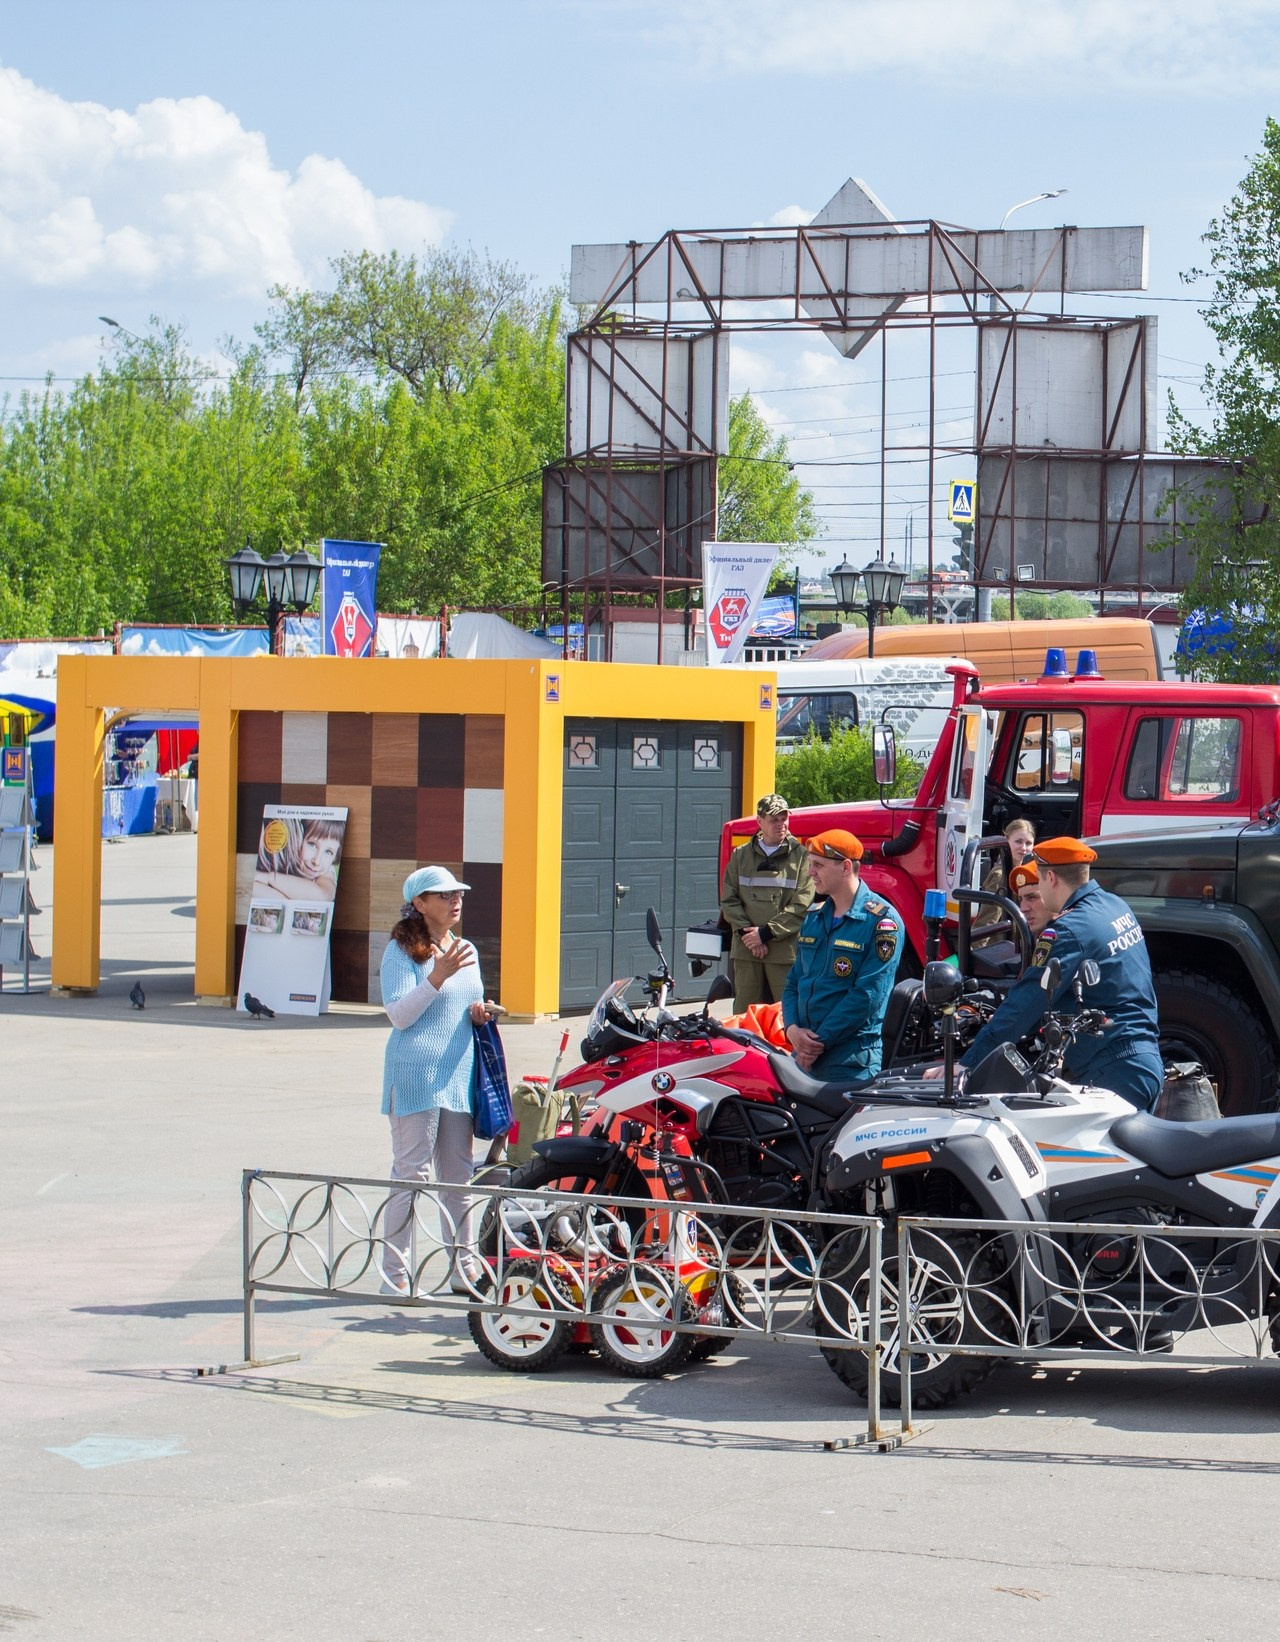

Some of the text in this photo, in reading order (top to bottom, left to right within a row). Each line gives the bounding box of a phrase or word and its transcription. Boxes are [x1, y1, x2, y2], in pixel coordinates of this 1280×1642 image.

[1111, 912, 1135, 935] МЧС
[1107, 924, 1145, 957] РОССИ
[855, 1127, 927, 1142] МЧС РОССИИ
